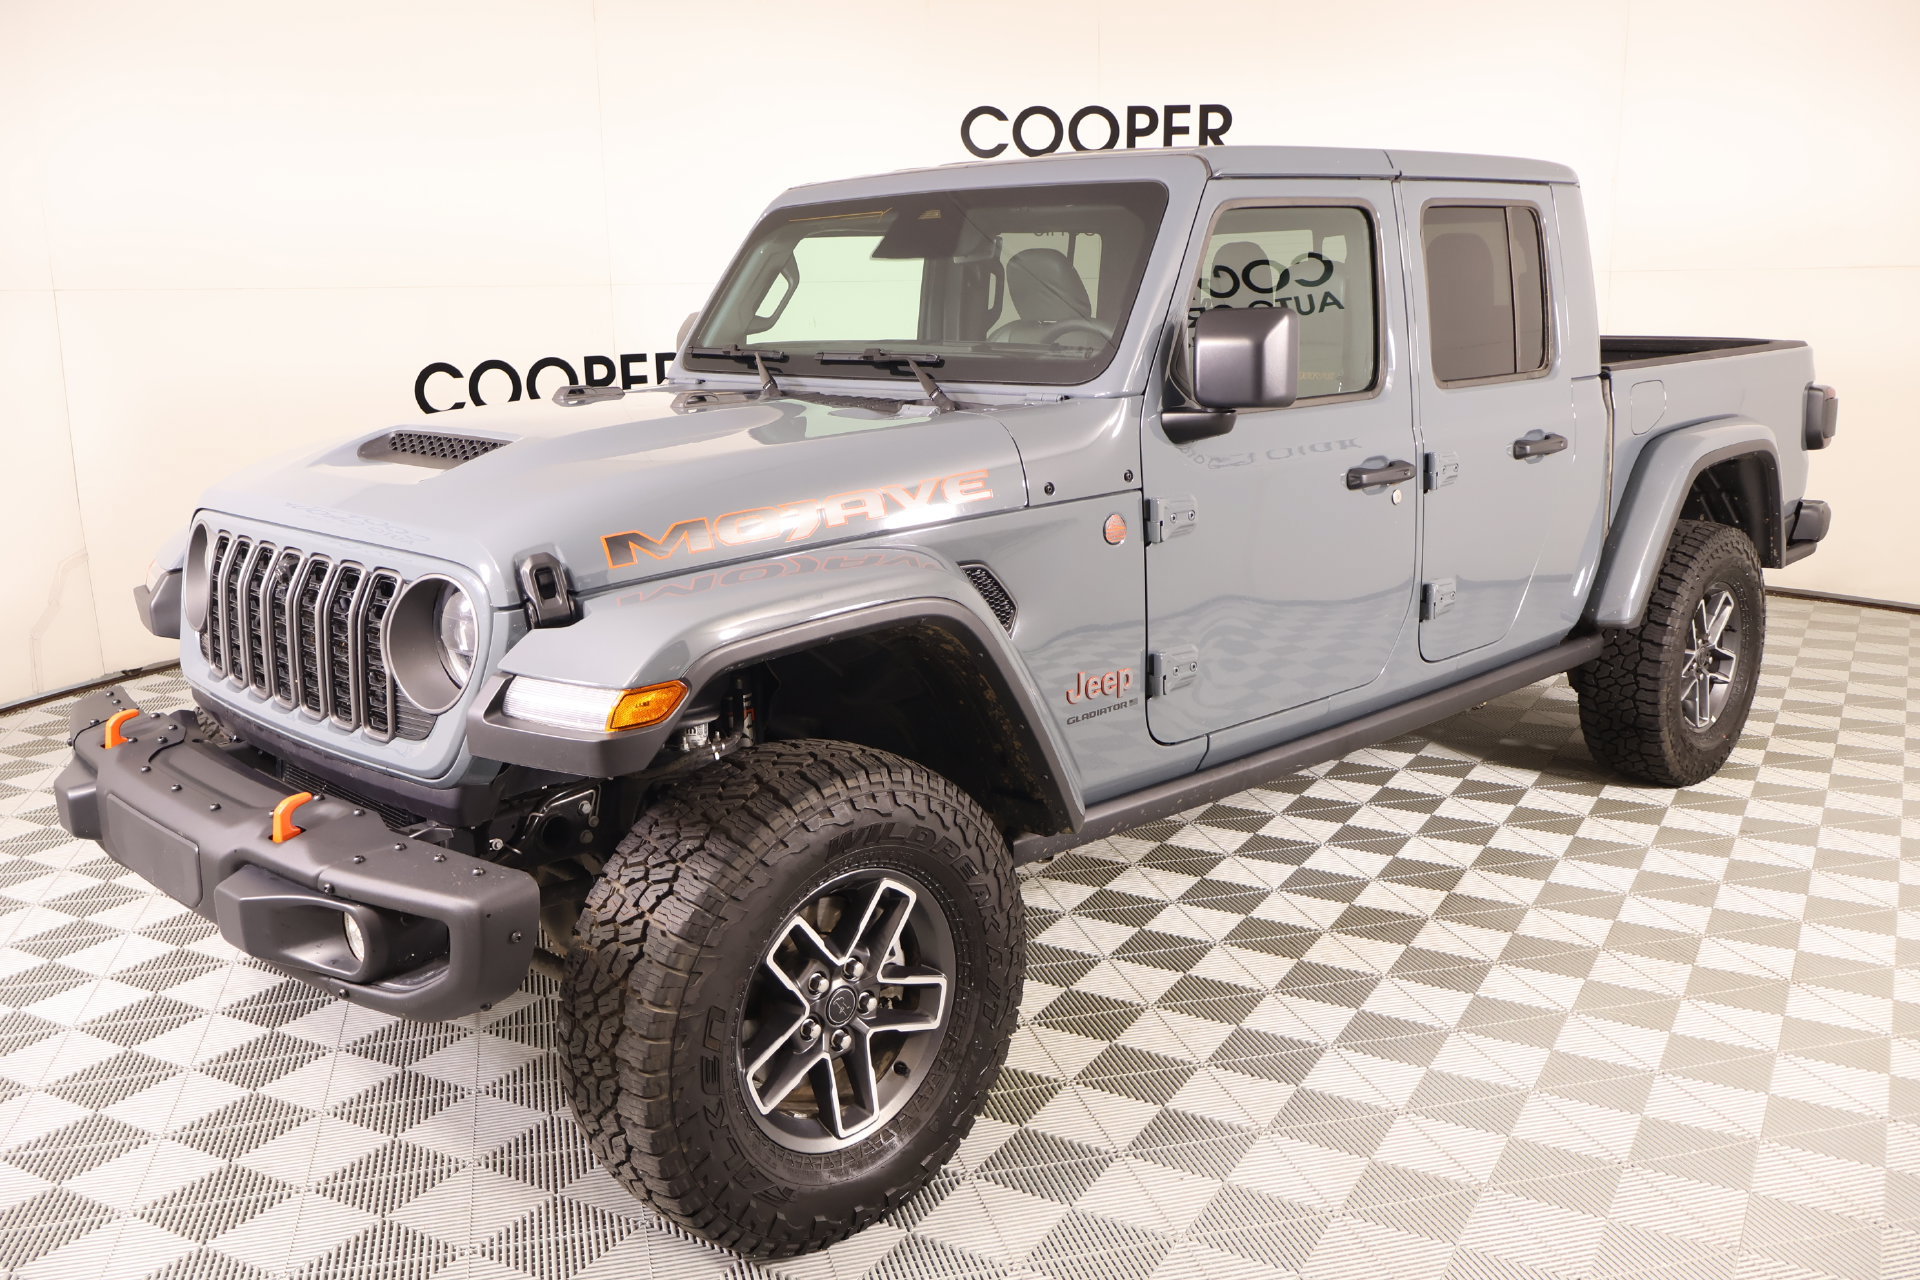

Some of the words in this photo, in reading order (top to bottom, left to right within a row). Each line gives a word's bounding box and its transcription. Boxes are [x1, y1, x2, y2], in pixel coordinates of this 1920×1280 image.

[960, 104, 1233, 158] COOPER
[600, 468, 994, 570] MOJAVE
[1066, 667, 1136, 705] Jeep
[1066, 701, 1128, 726] GLADIATOR
[824, 821, 1002, 935] WILDPEAK
